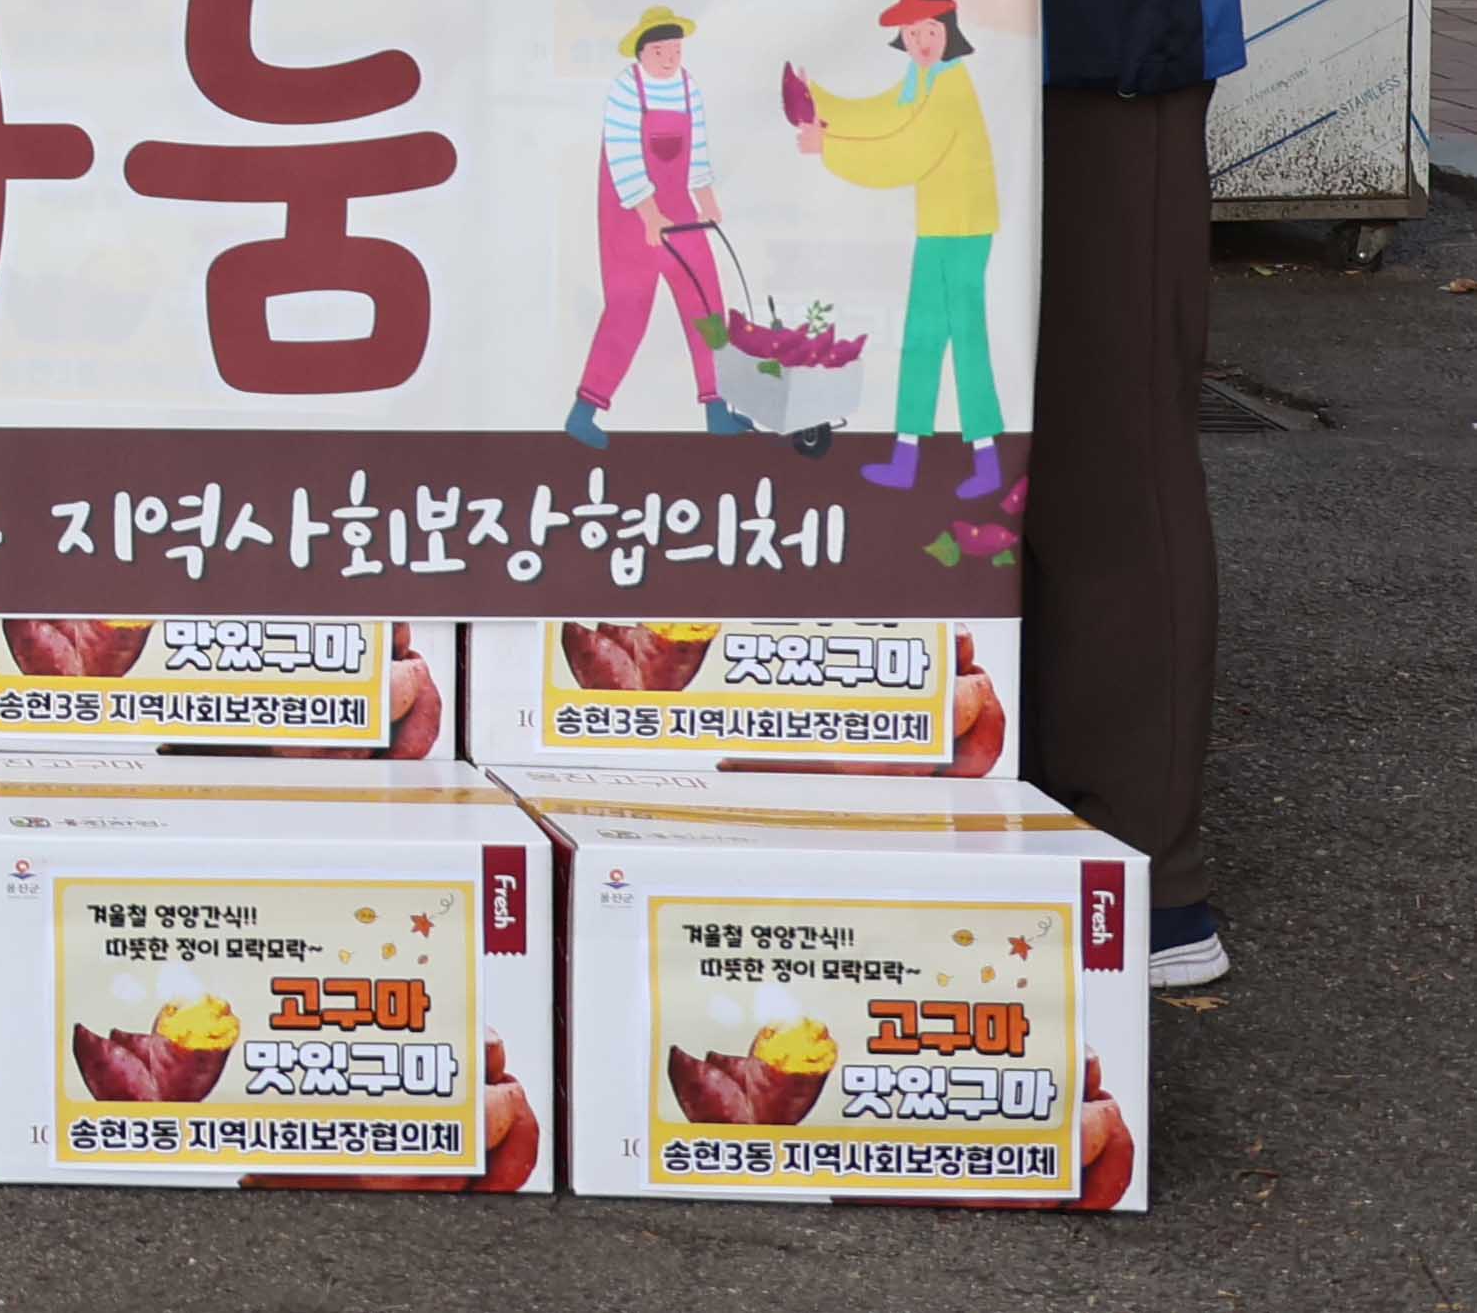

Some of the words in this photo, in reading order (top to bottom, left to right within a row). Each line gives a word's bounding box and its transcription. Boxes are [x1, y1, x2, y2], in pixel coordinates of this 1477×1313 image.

[1338, 73, 1402, 116] STAINLESS
[51, 467, 844, 586] 지역사회보장협의체
[165, 621, 367, 673] 맛있구마
[725, 634, 930, 688] 맛있구마
[109, 692, 366, 725] 지역사회보장협의체
[556, 705, 660, 736] 송현3동
[668, 707, 930, 741] 지역사회보장협의체
[681, 922, 743, 948] 겨울철
[750, 924, 855, 950] 영양간식!!
[1091, 890, 1115, 945] Fresh
[698, 956, 765, 982] 따뜻한
[771, 958, 816, 983] 정이
[822, 959, 922, 984] 모락모락~
[269, 976, 430, 1033] 고구마
[865, 999, 1031, 1057] 고구마
[242, 1042, 457, 1096] 맛있구마
[838, 1065, 1056, 1121] 맛있구마
[70, 1118, 179, 1149] 송현3동
[188, 1119, 461, 1152] 지역사회보장협의체
[663, 1140, 773, 1171] 송현3동
[782, 1141, 1057, 1176] 지역사회보장협의체
